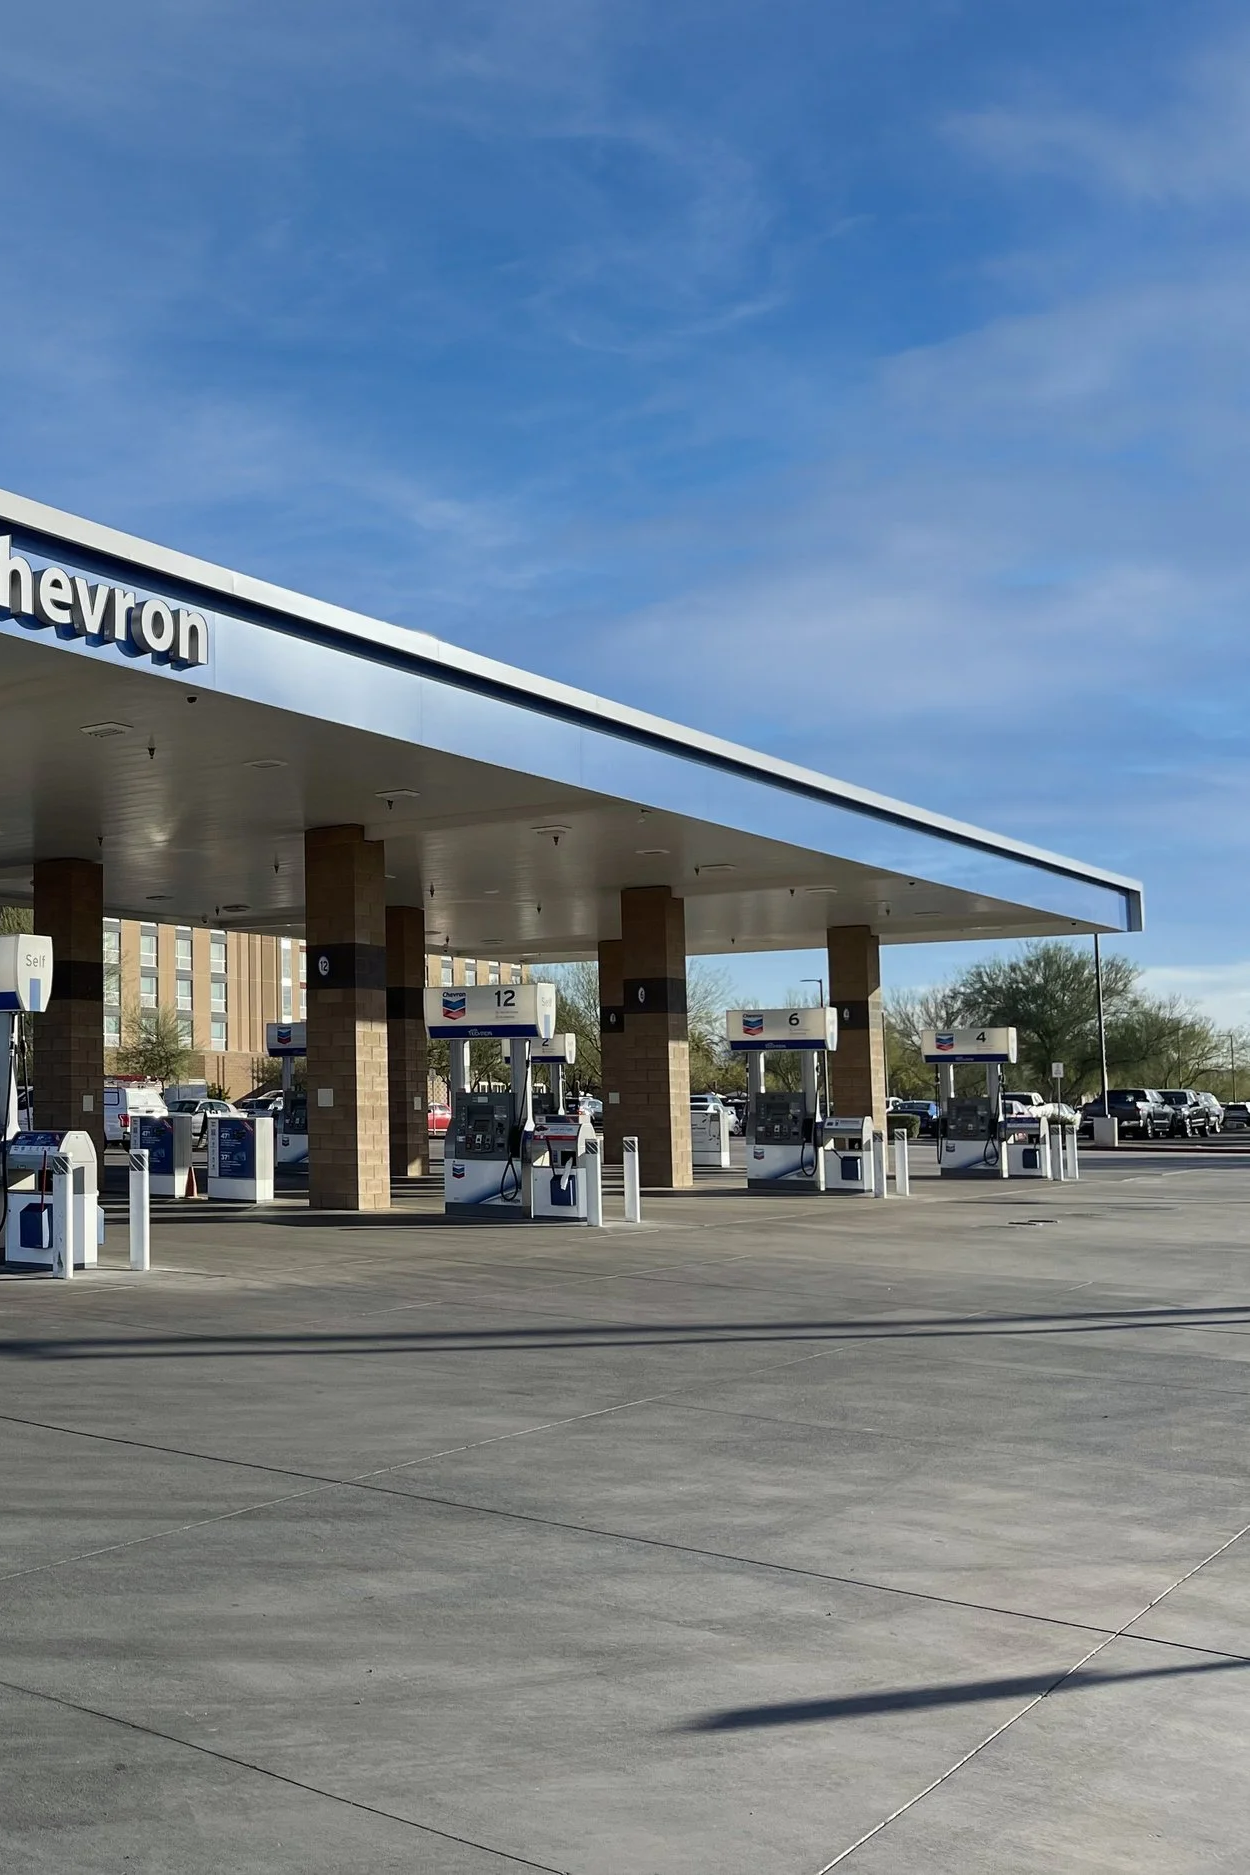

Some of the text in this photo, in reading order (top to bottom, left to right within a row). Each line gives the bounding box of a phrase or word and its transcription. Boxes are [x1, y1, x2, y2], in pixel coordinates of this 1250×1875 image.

[25, 954, 46, 969] Self
[320, 960, 328, 972] 12
[494, 990, 516, 1007] 12
[788, 1013, 800, 1026] 6
[541, 1038, 549, 1047] 2
[975, 1031, 987, 1043] 4
